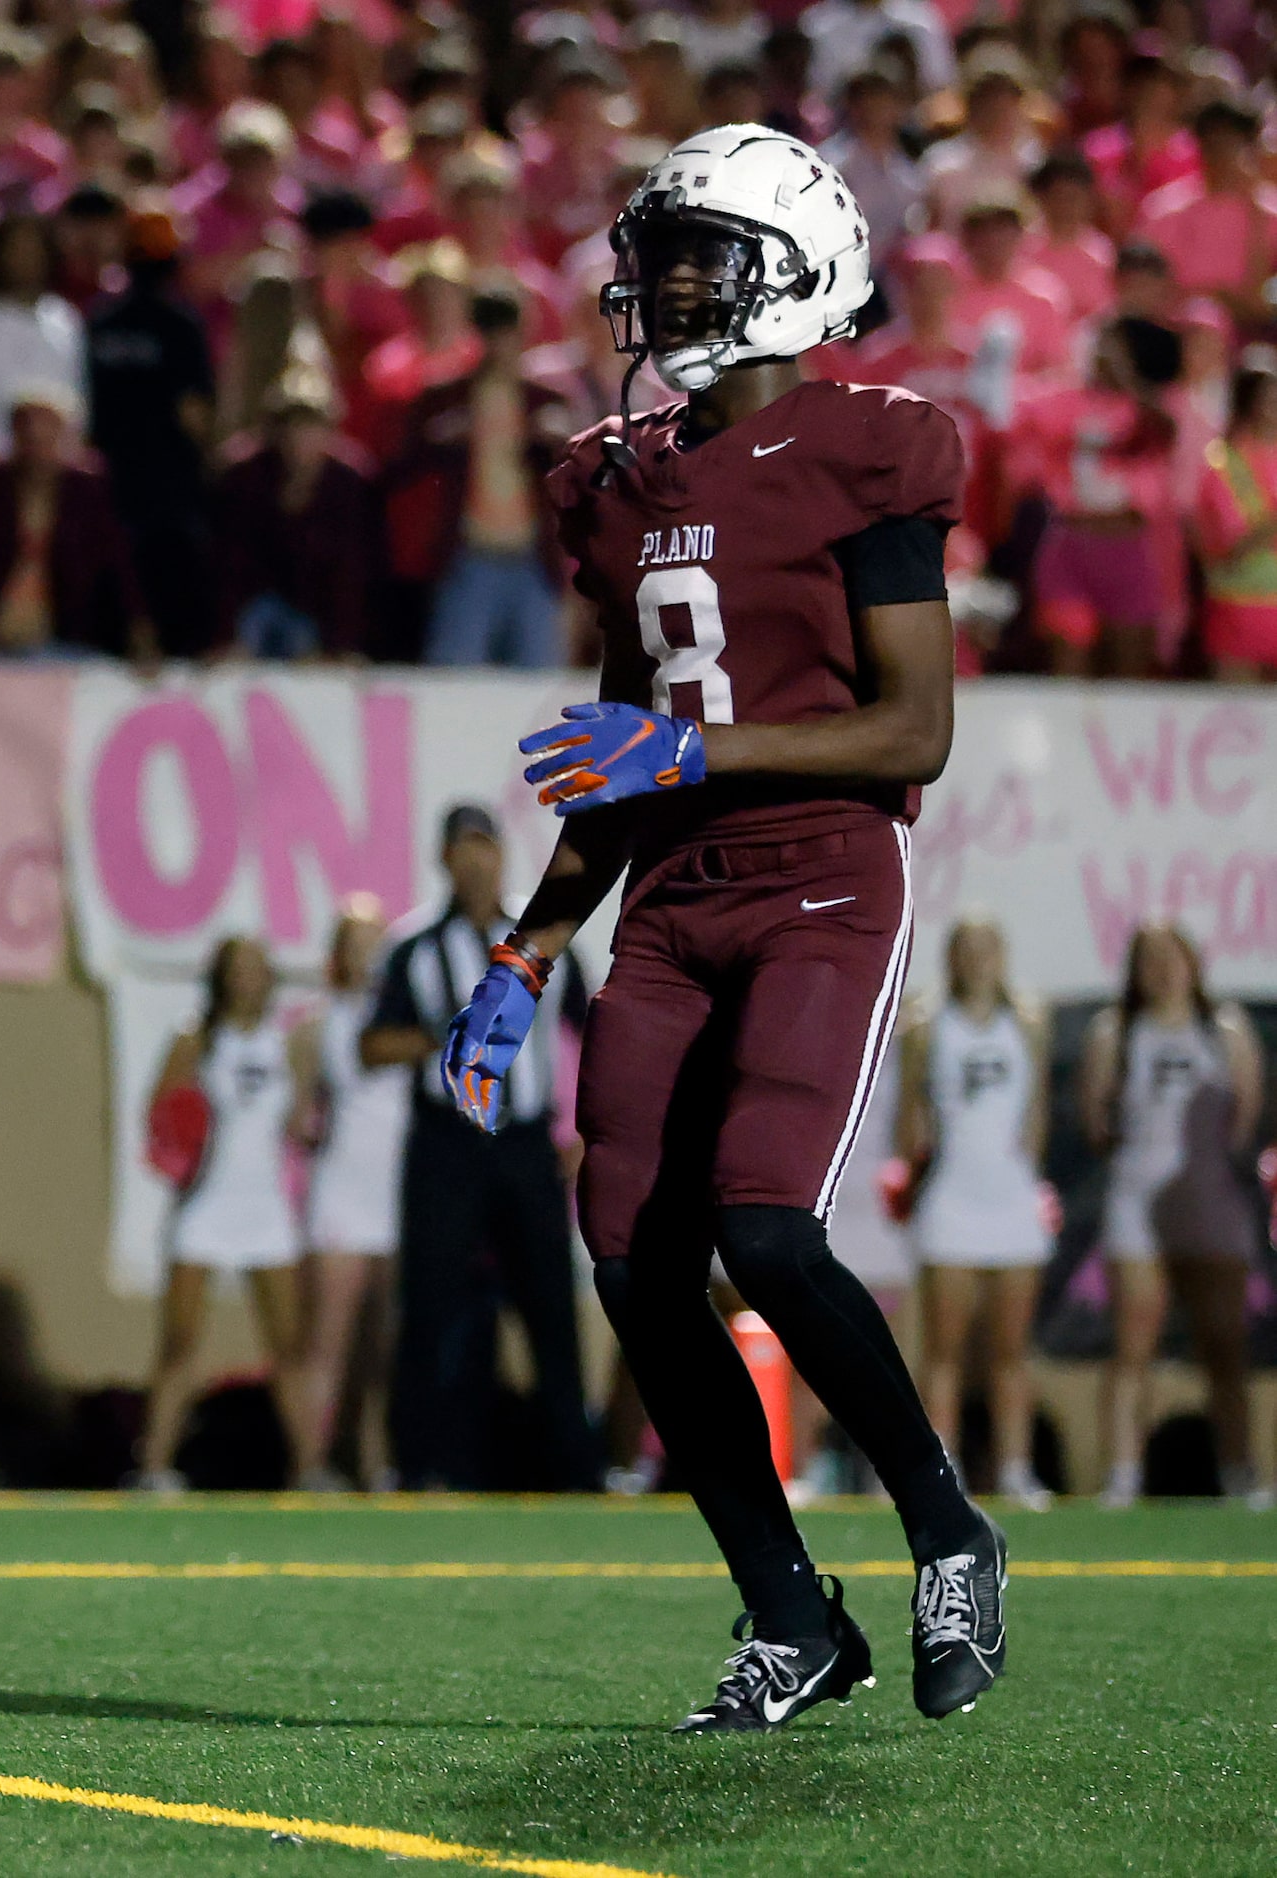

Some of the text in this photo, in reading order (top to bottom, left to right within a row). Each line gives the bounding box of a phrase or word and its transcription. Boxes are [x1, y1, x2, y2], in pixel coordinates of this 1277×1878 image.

[637, 525, 715, 566] PLANO
[636, 566, 733, 725] 8
[89, 680, 414, 945] ON
